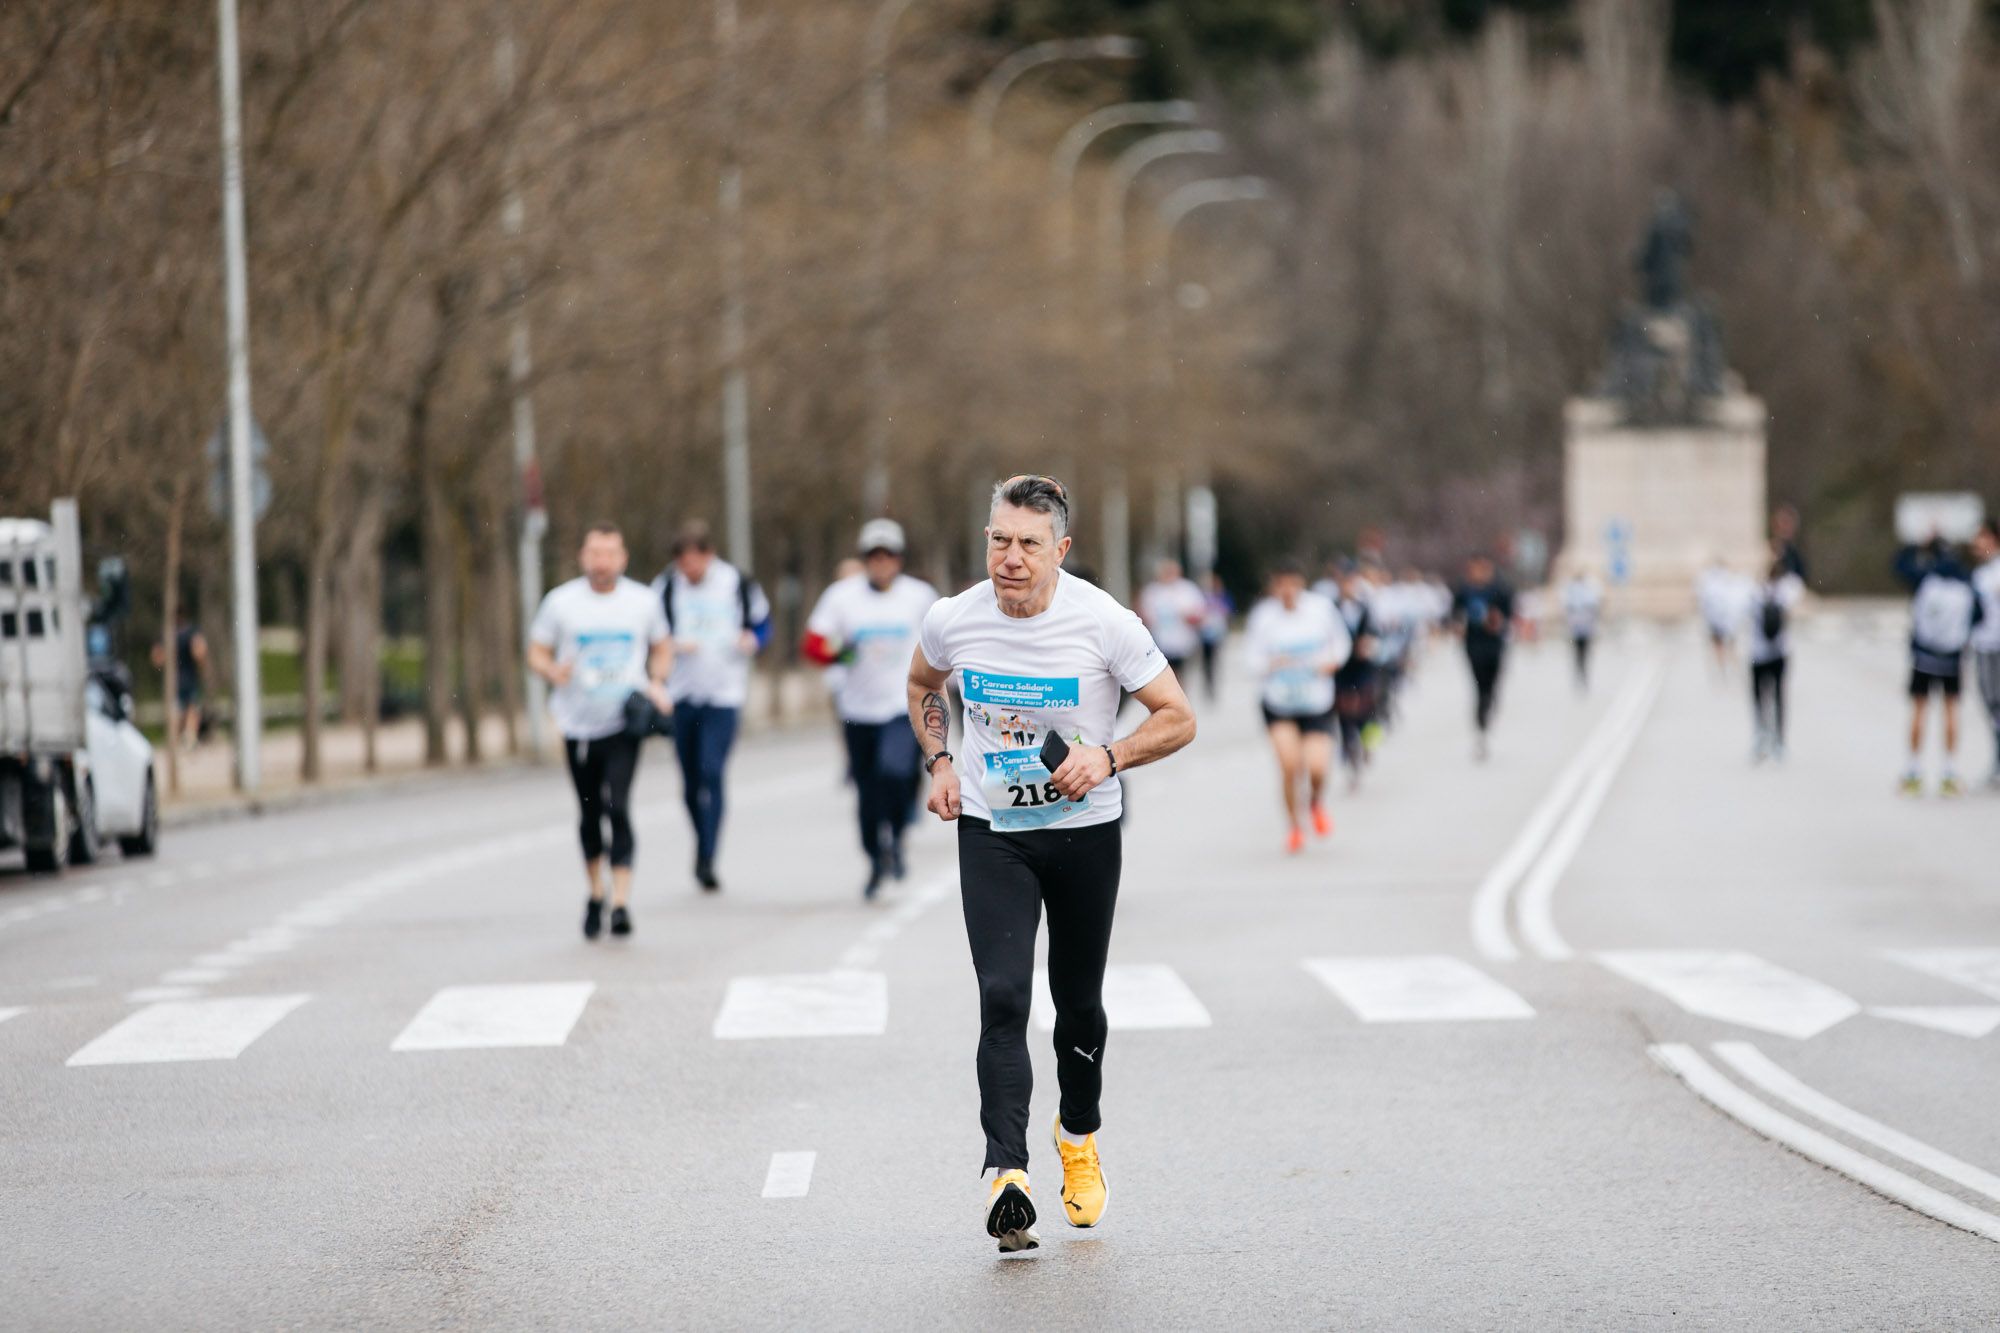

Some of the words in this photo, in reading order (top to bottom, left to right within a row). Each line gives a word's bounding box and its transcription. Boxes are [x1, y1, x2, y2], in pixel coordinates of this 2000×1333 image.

[982, 679, 1014, 690] Carrera
[1016, 682, 1053, 691] Solidaria
[1044, 699, 1075, 709] 2026
